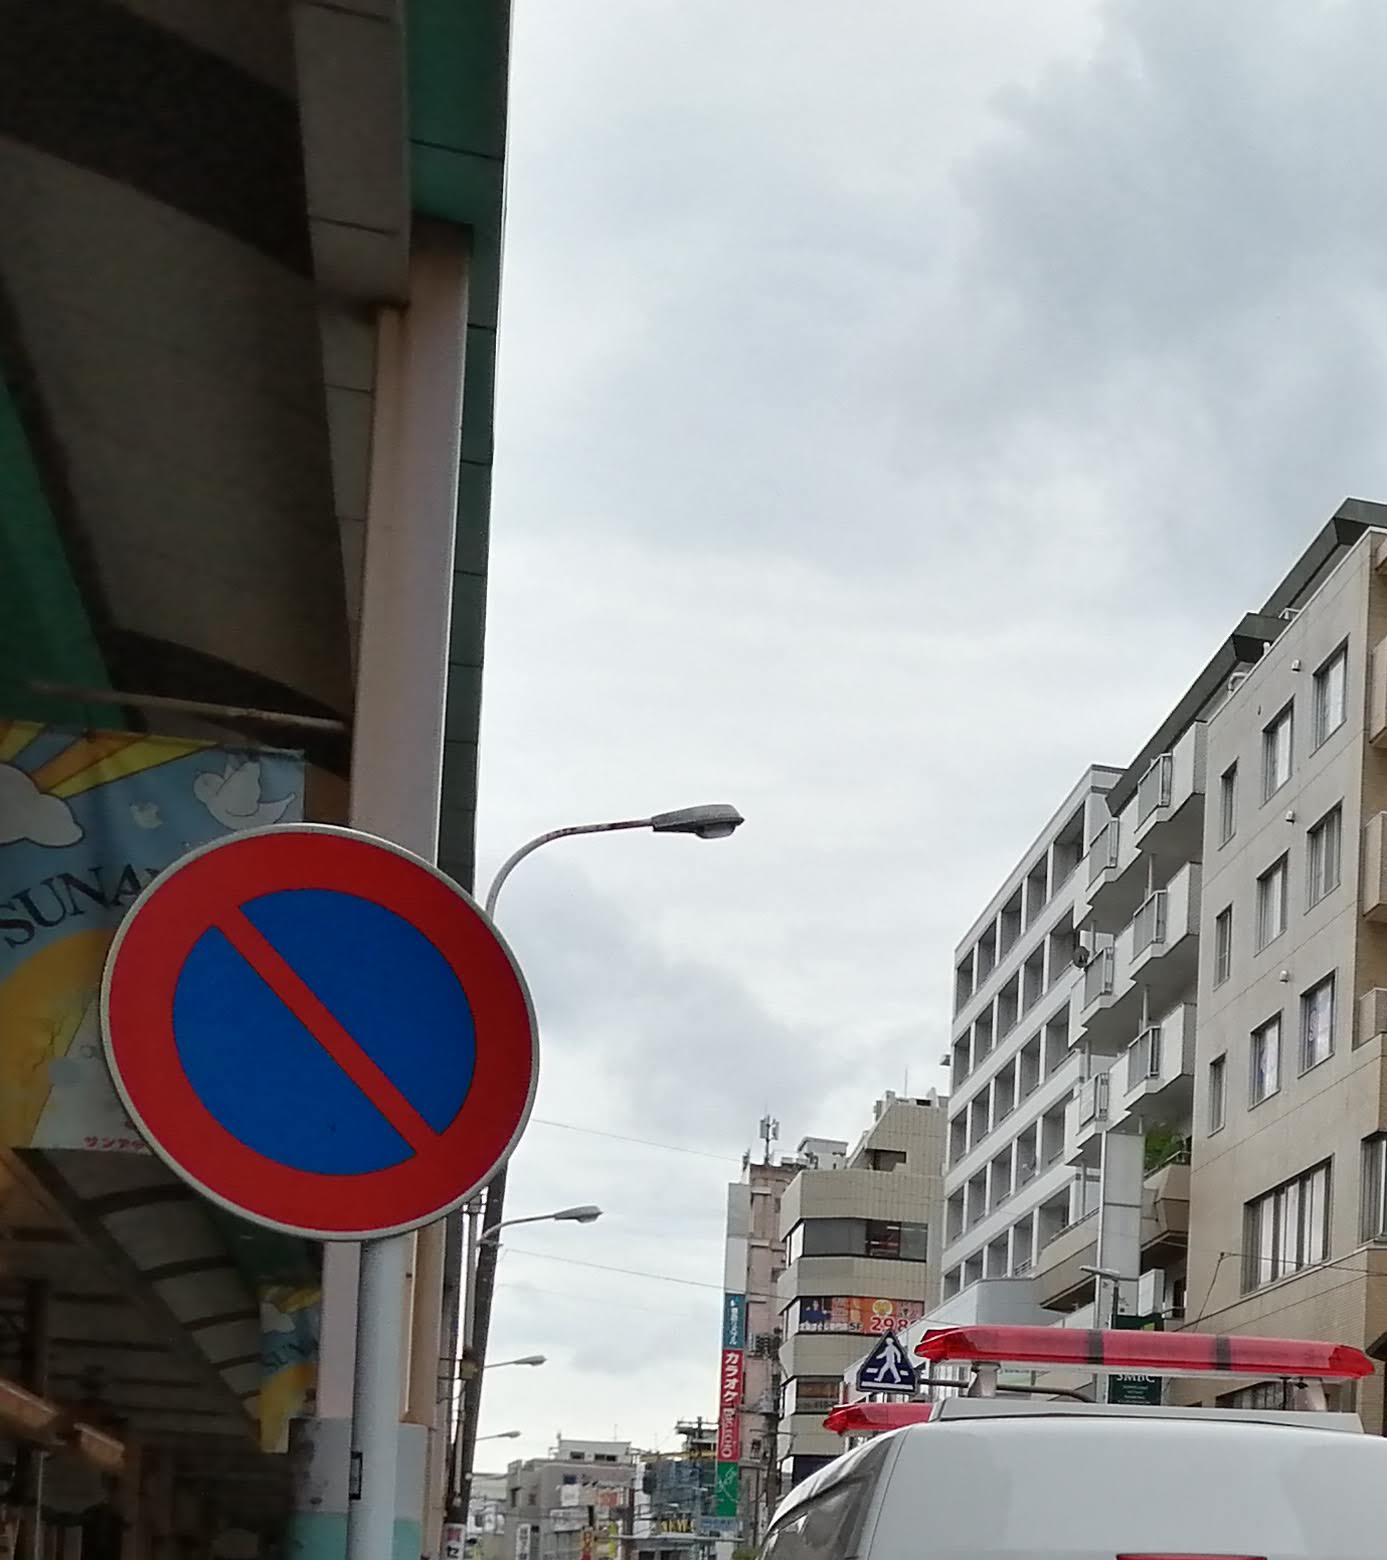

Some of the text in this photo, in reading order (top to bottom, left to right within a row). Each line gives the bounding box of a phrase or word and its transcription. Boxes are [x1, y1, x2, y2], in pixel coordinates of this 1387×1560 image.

[0, 863, 161, 949] SUNA
[722, 1352, 740, 1403] カラオケ
